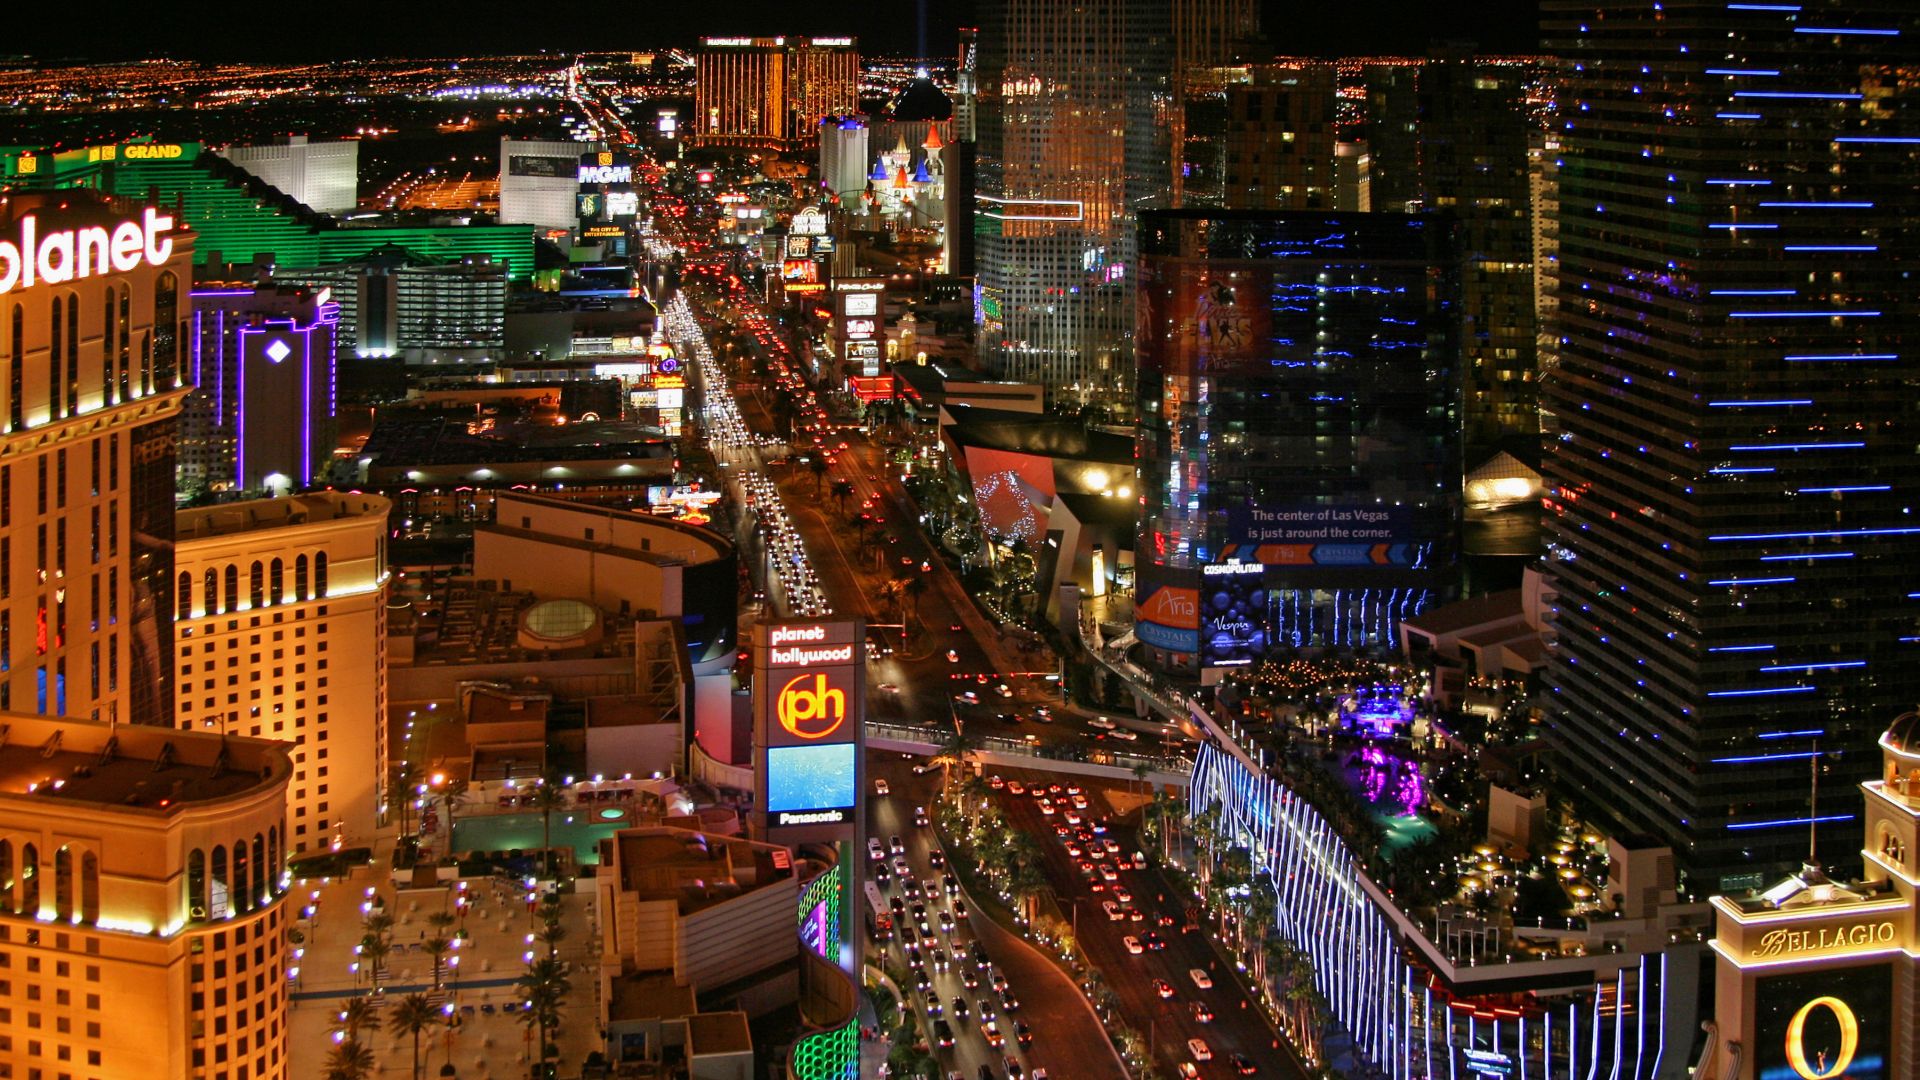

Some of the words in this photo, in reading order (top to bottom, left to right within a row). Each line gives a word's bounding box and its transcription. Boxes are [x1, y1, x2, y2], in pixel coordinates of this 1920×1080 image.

[125, 145, 182, 159] GRAND
[579, 166, 632, 183] MGM
[1252, 510, 1275, 521] The
[1277, 511, 1315, 521] center
[1317, 509, 1330, 521] of
[1332, 510, 1351, 521] Las
[1353, 510, 1390, 523] Vegas
[1248, 527, 1258, 538] is
[1259, 527, 1283, 541] just
[1286, 527, 1328, 538] around
[1330, 527, 1350, 538] the
[1352, 529, 1392, 538] corner.
[1204, 564, 1263, 575] COSMOPOLITAN
[1227, 558, 1241, 566] THE
[1157, 589, 1195, 616] Aria
[771, 626, 825, 646] planet
[1143, 624, 1192, 642] CRYSTALS
[771, 646, 851, 666] hollywood
[784, 673, 845, 731] ph
[779, 810, 843, 826] Panasonic
[1751, 922, 1895, 958] BELLAGIO
[1784, 995, 1858, 1080] O
